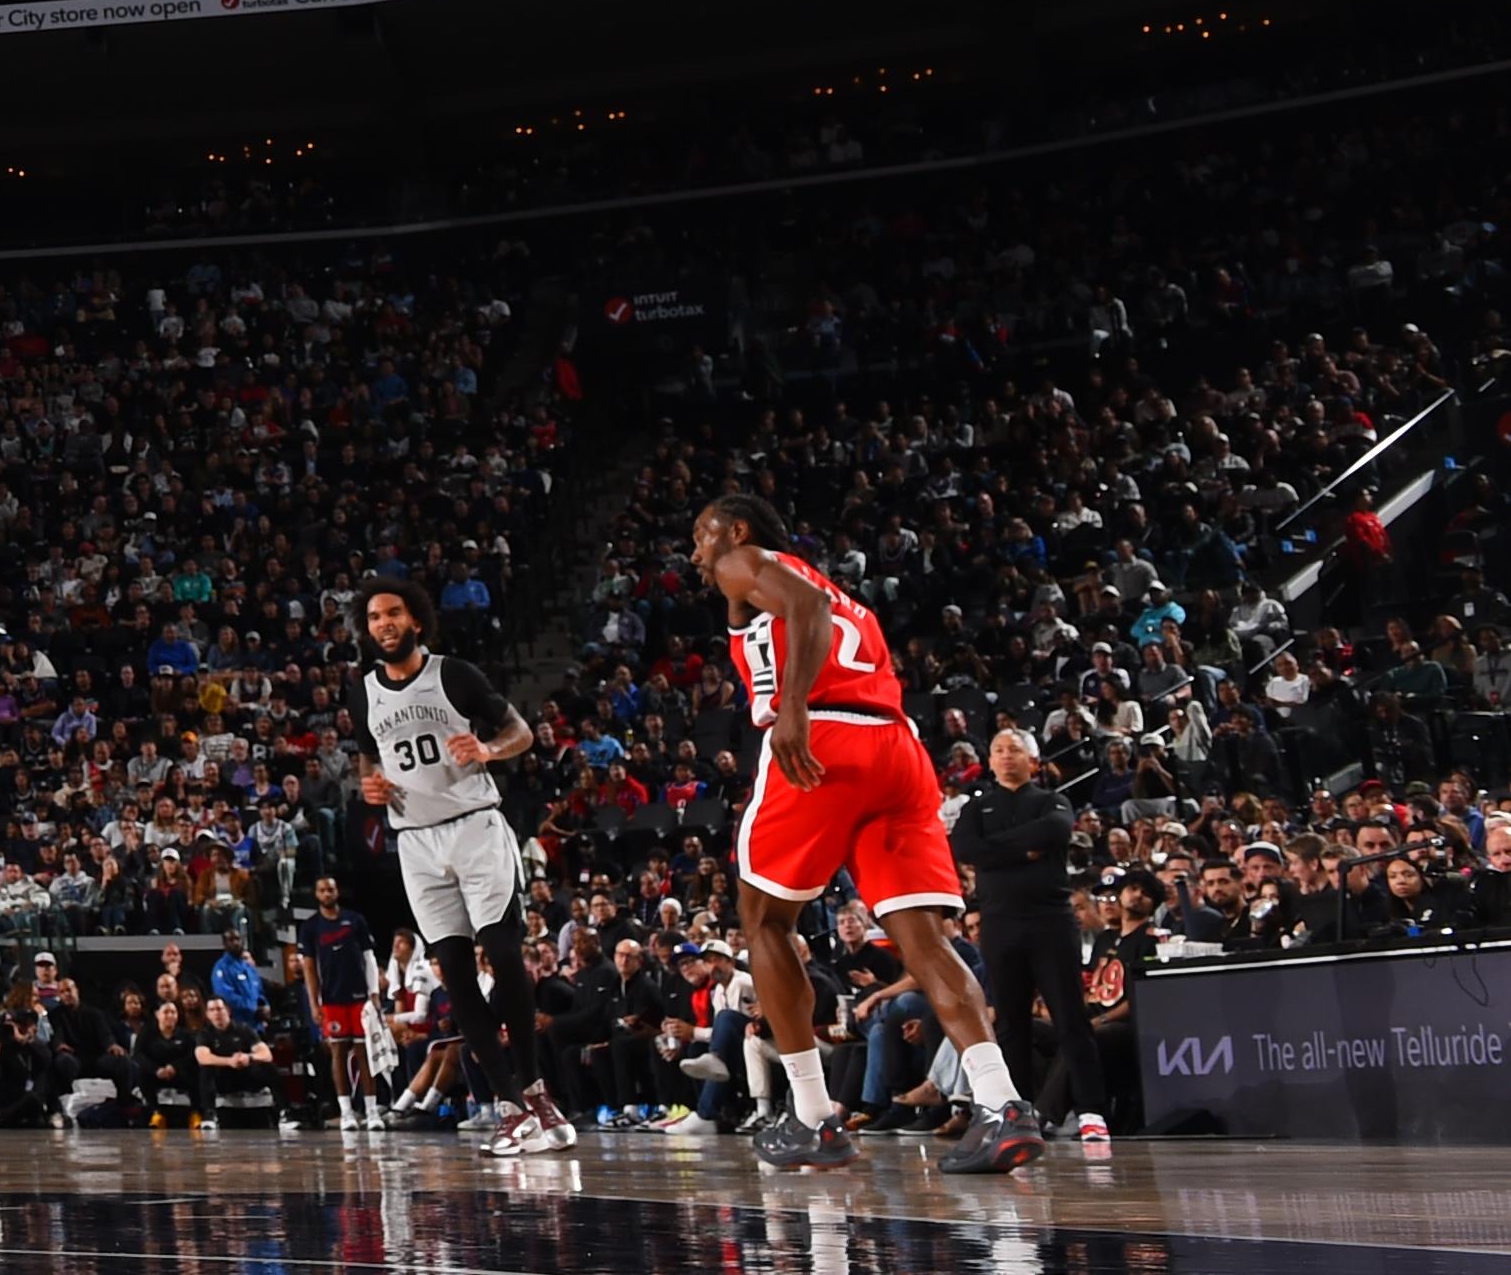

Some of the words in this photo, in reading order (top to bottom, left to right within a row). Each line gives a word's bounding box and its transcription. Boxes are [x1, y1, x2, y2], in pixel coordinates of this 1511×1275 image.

[831, 613, 876, 673] 2
[394, 704, 449, 725] ANTONIO
[393, 733, 441, 772] 30
[1157, 1035, 1233, 1076] KIA
[1252, 1033, 1296, 1071] The
[1302, 1030, 1385, 1070] all-new
[1391, 1023, 1503, 1068] Telluride
